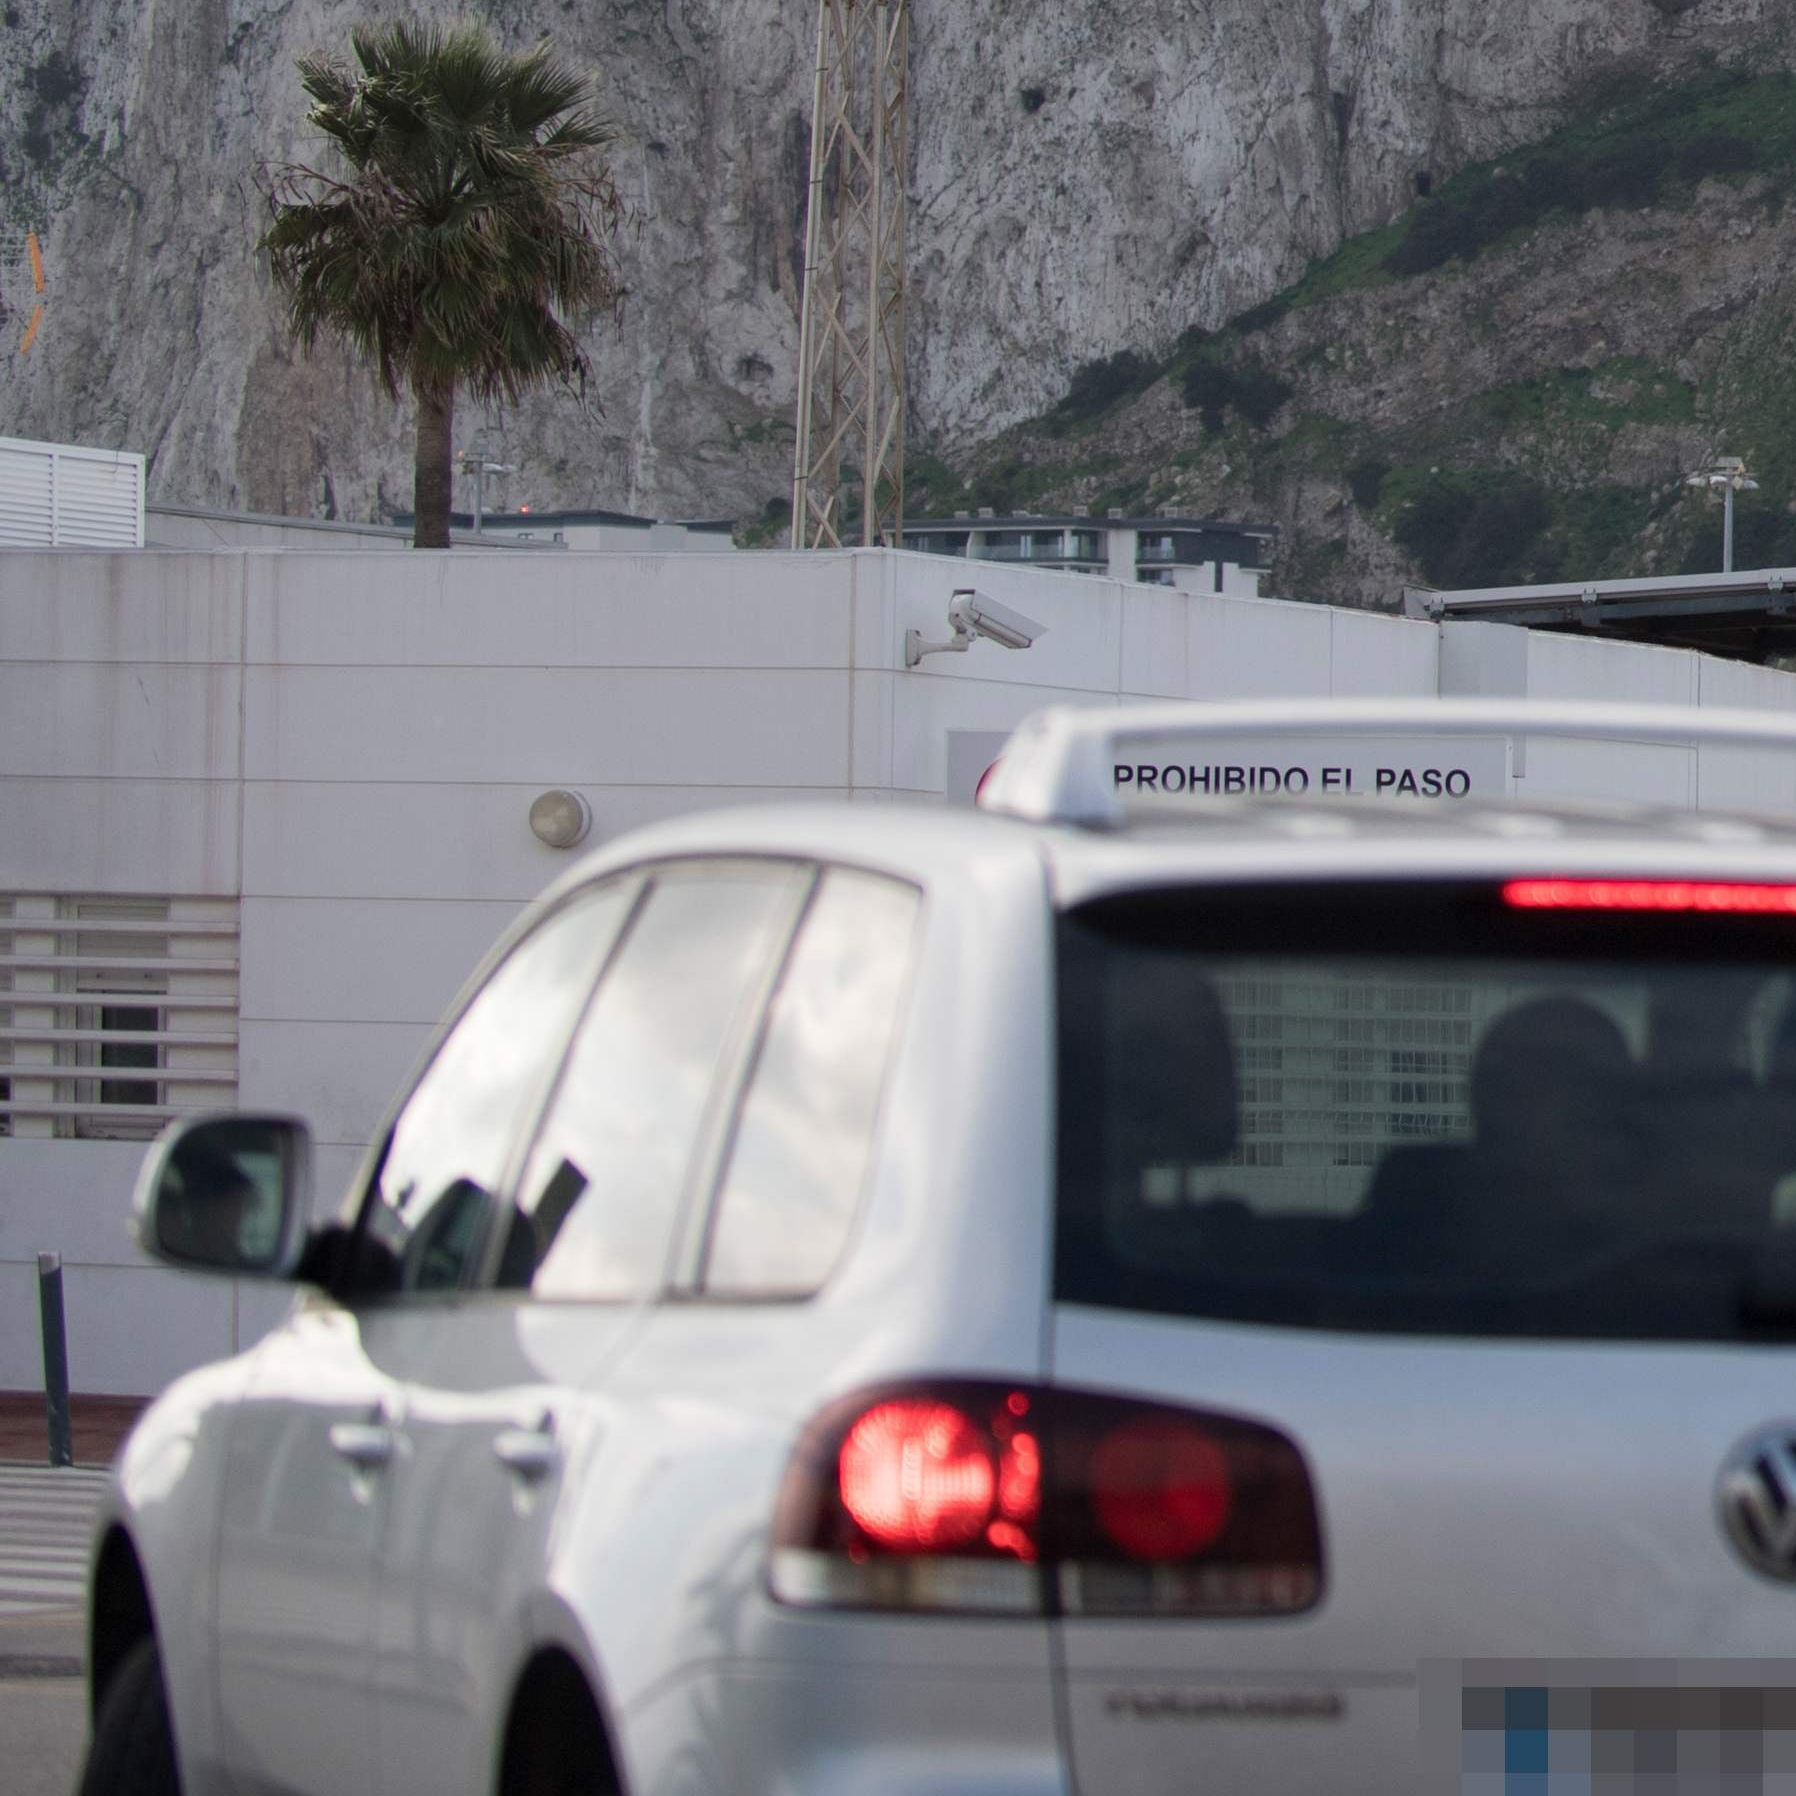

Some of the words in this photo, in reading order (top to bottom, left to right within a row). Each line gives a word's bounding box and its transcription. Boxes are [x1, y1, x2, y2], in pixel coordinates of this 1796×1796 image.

[1113, 763, 1309, 795] PROHIBIDO
[1321, 767, 1364, 795] EL
[1376, 768, 1471, 799] PASO
